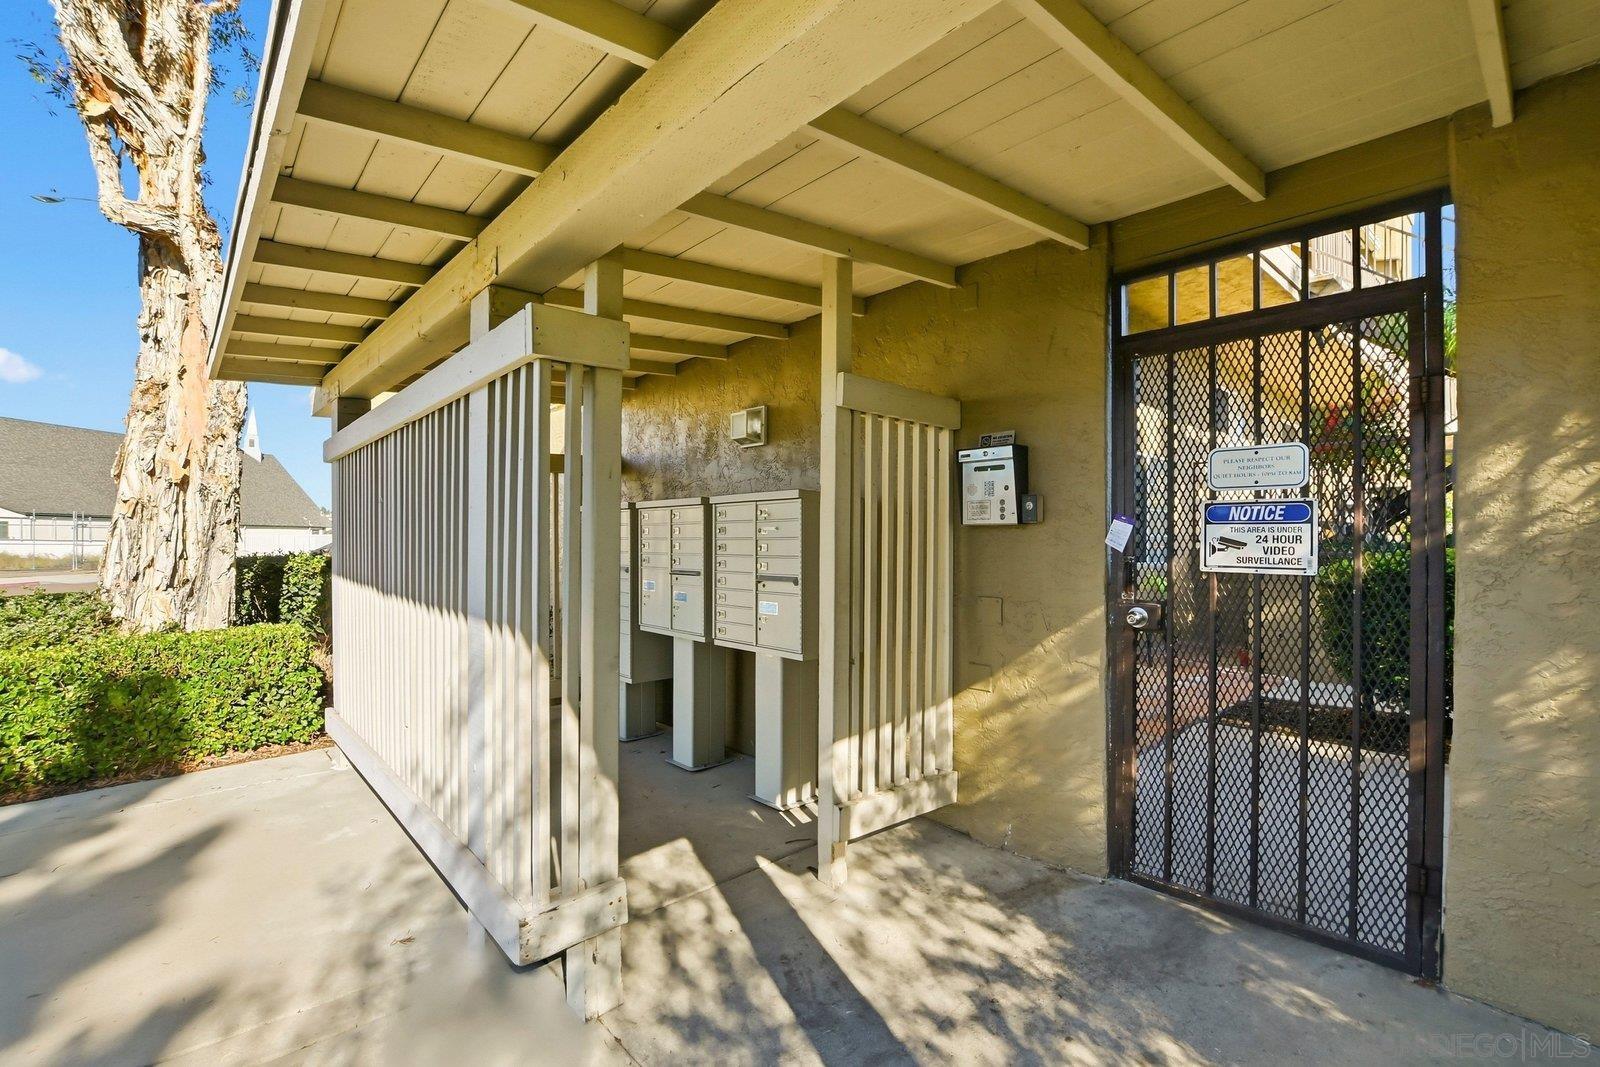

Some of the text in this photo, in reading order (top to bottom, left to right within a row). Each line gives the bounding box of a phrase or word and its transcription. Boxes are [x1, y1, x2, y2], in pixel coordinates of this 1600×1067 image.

[1228, 505, 1286, 520] NOTICE
[1255, 535, 1303, 544] 24 HOUR
[1262, 546, 1295, 555] VIDEO
[1236, 556, 1302, 566] SURVEILLANCE
